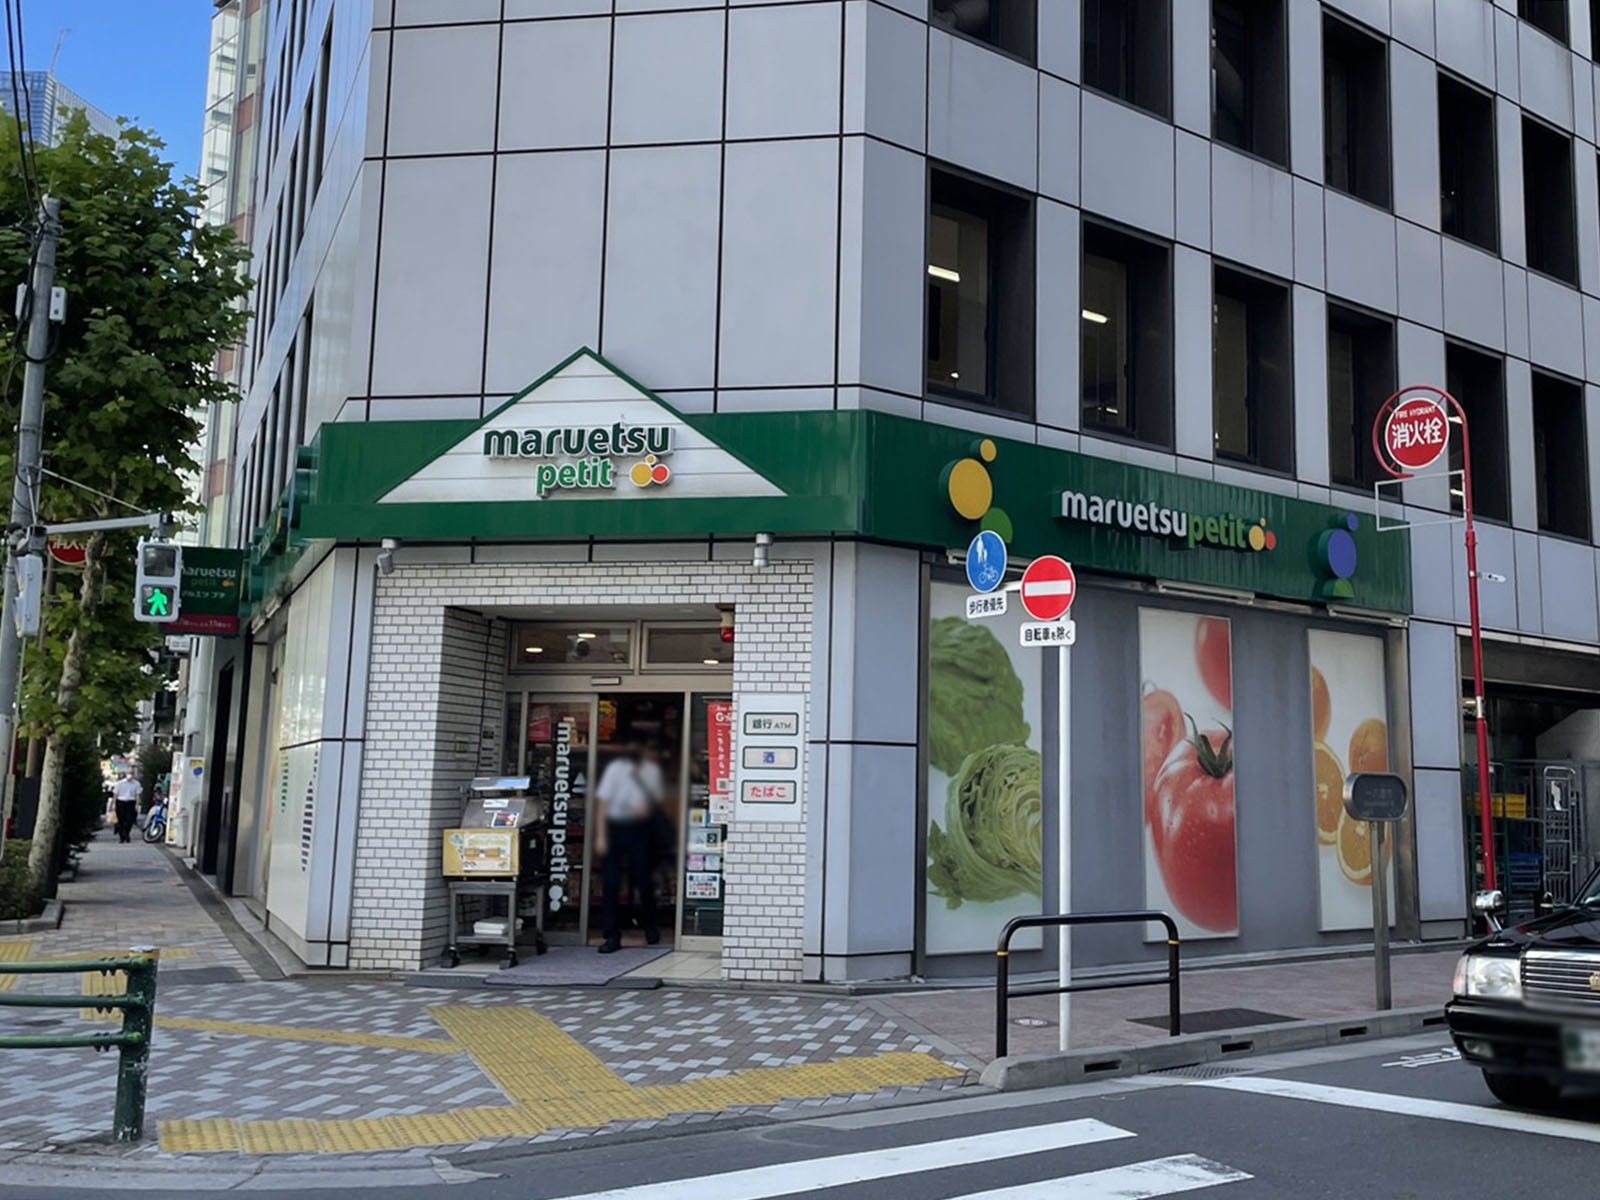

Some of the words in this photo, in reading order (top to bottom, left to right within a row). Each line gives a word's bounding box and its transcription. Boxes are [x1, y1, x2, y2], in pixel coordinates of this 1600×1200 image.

[483, 421, 671, 456] maruetsu
[1391, 417, 1443, 449] 消火栓
[536, 457, 613, 496] petit
[1061, 490, 1187, 538] maruetsu
[1187, 511, 1246, 549] petit
[181, 567, 236, 577] aruetsu
[969, 597, 1004, 615] 歩行者優先
[1024, 626, 1071, 642] 自転車を除く
[752, 718, 772, 729] 銀行
[762, 751, 775, 764] 酒
[553, 721, 572, 826] maruetsu
[750, 785, 787, 798] たばこ
[547, 829, 571, 882] petit
